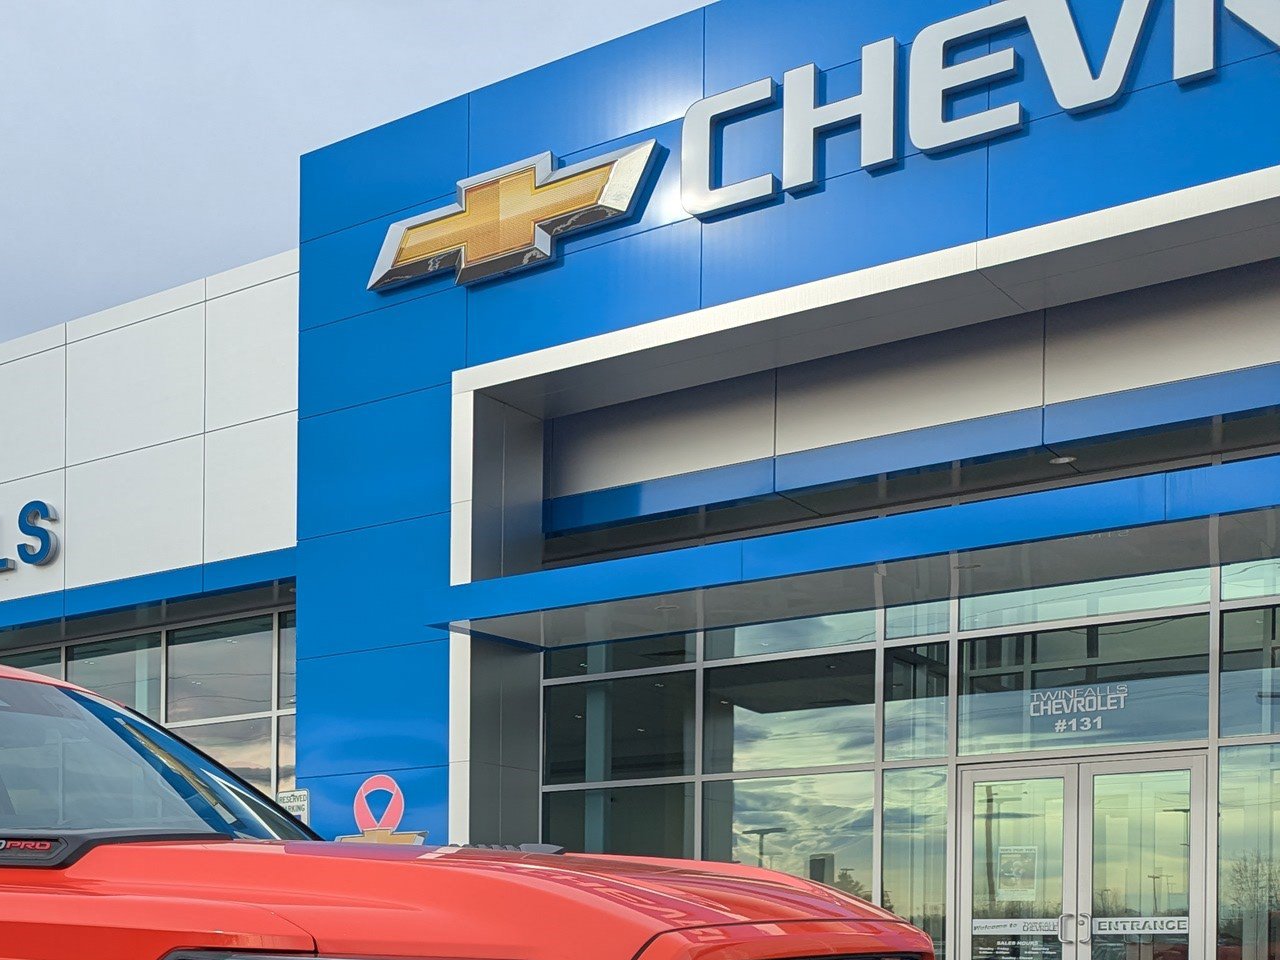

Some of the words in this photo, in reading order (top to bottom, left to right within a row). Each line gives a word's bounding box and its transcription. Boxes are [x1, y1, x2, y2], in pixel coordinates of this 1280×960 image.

[1030, 684, 1128, 702] TWINFALLS
[1029, 693, 1128, 717] CHEVROLET
[1054, 715, 1103, 733] #131
[279, 794, 306, 803] RESERVED
[284, 804, 305, 812] ARKING
[1097, 919, 1188, 932] ENTRANCE
